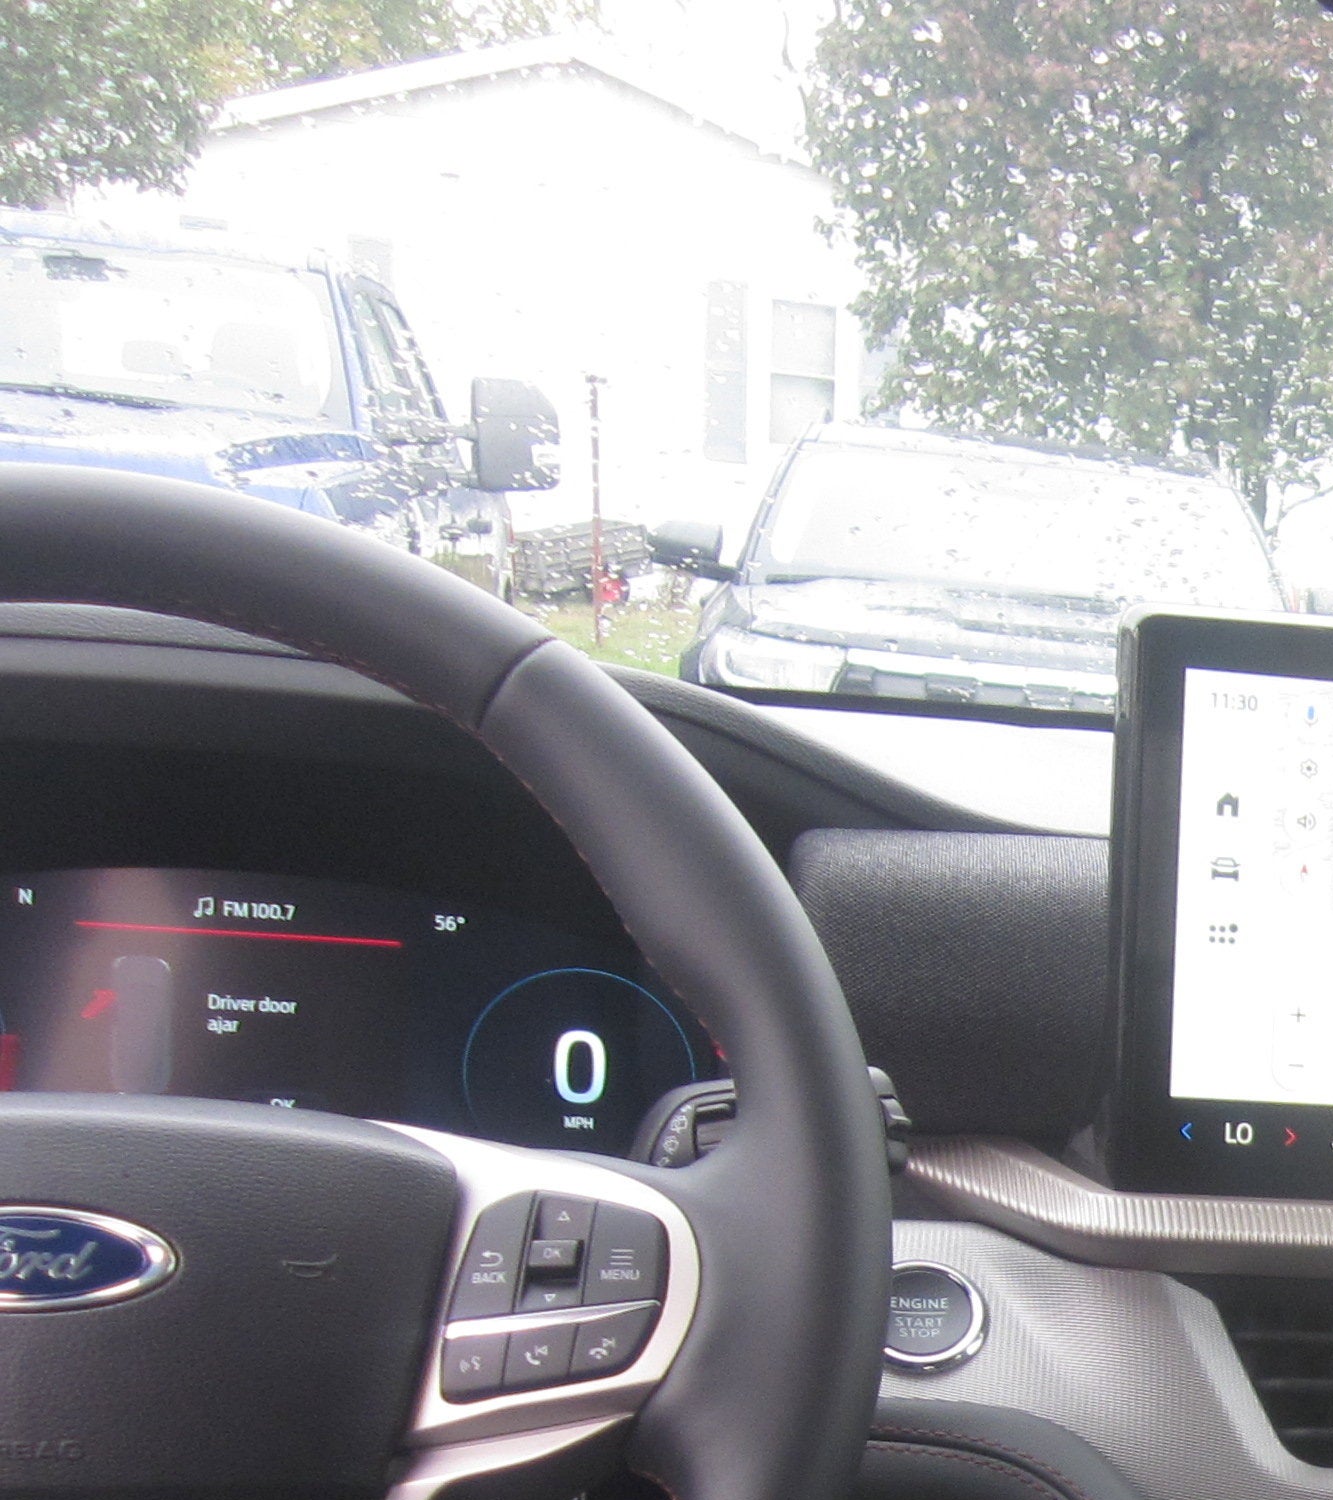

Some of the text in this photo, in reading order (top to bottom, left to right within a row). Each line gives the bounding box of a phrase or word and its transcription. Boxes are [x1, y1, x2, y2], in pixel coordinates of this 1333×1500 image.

[1210, 692, 1258, 712] 11:30
[18, 888, 33, 904] N
[207, 994, 297, 1015] Driver door
[207, 1017, 240, 1034] ajar
[554, 1029, 607, 1104] 0
[563, 1116, 594, 1129] MPH
[1224, 1122, 1253, 1144] LO
[472, 1271, 507, 1284] BACK
[600, 1269, 640, 1281] MENU
[890, 1296, 949, 1310] ENGINE
[895, 1316, 944, 1328] START
[899, 1328, 940, 1338] STOP
